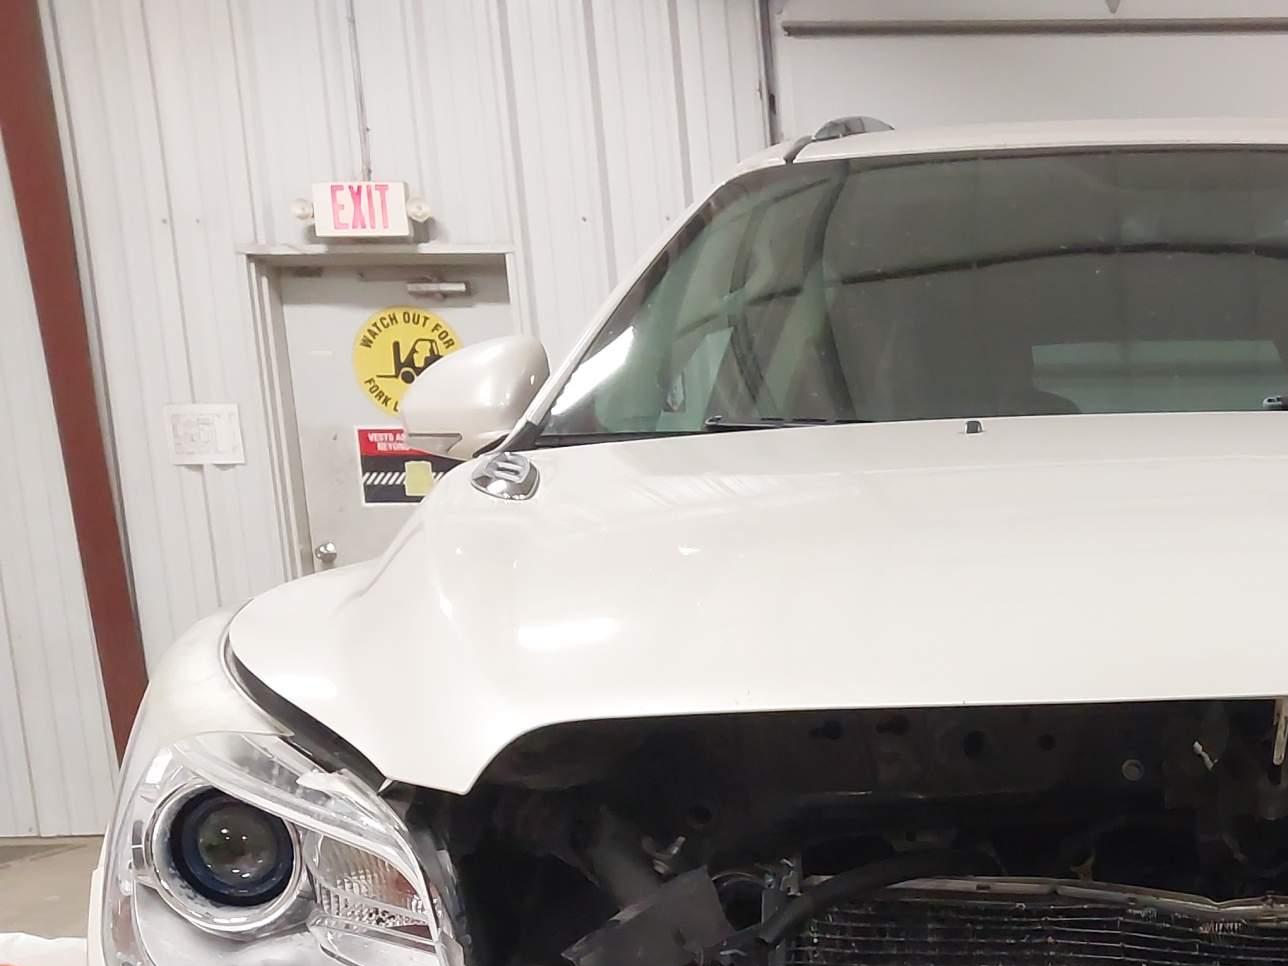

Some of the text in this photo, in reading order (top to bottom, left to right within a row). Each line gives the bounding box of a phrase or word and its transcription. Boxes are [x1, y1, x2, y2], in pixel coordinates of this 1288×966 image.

[330, 184, 389, 229] EXIT
[360, 311, 456, 349] WATCH OUT FOR
[364, 378, 392, 407] FORK
